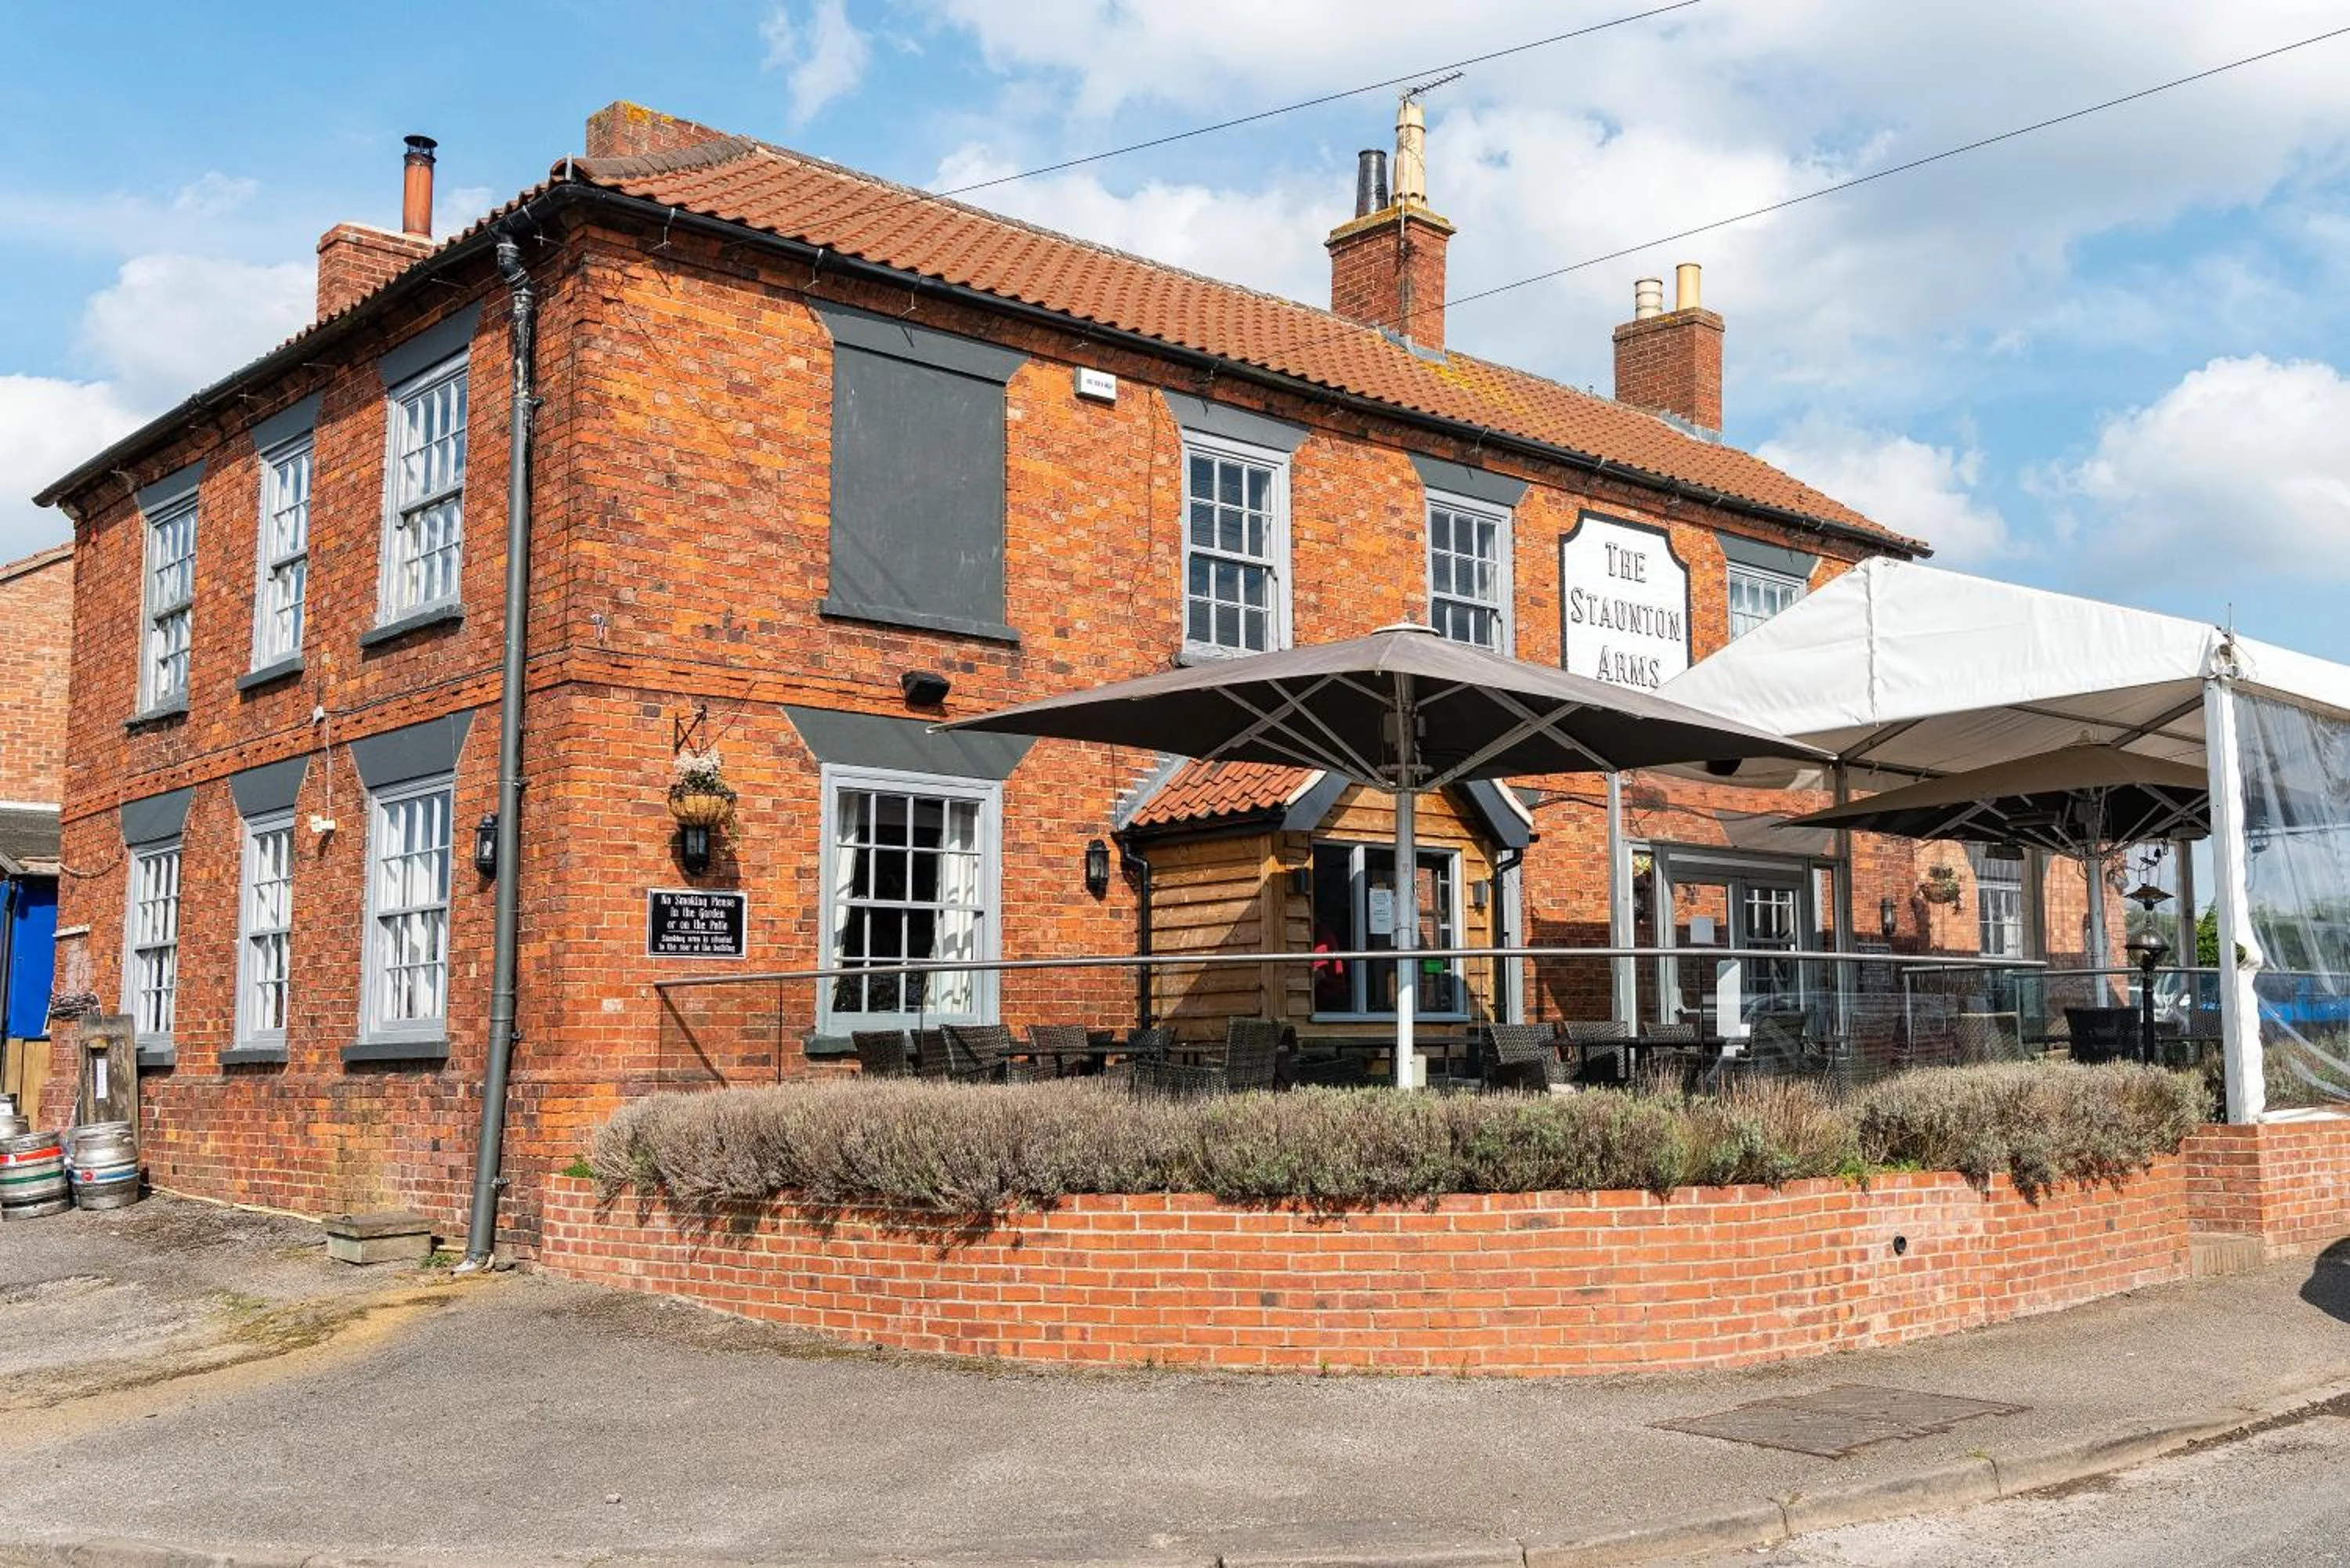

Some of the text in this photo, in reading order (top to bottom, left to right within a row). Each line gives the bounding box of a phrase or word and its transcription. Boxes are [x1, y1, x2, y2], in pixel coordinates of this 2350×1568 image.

[1605, 541, 1647, 583] THE
[1571, 587, 1681, 641] STAUNTON
[1596, 645, 1660, 688] ARMS
[660, 894, 736, 907] No Smoking Please
[682, 907, 695, 917] the
[698, 909, 726, 919] Garden
[667, 919, 728, 930] or on the Patio
[661, 934, 685, 943] Smoking
